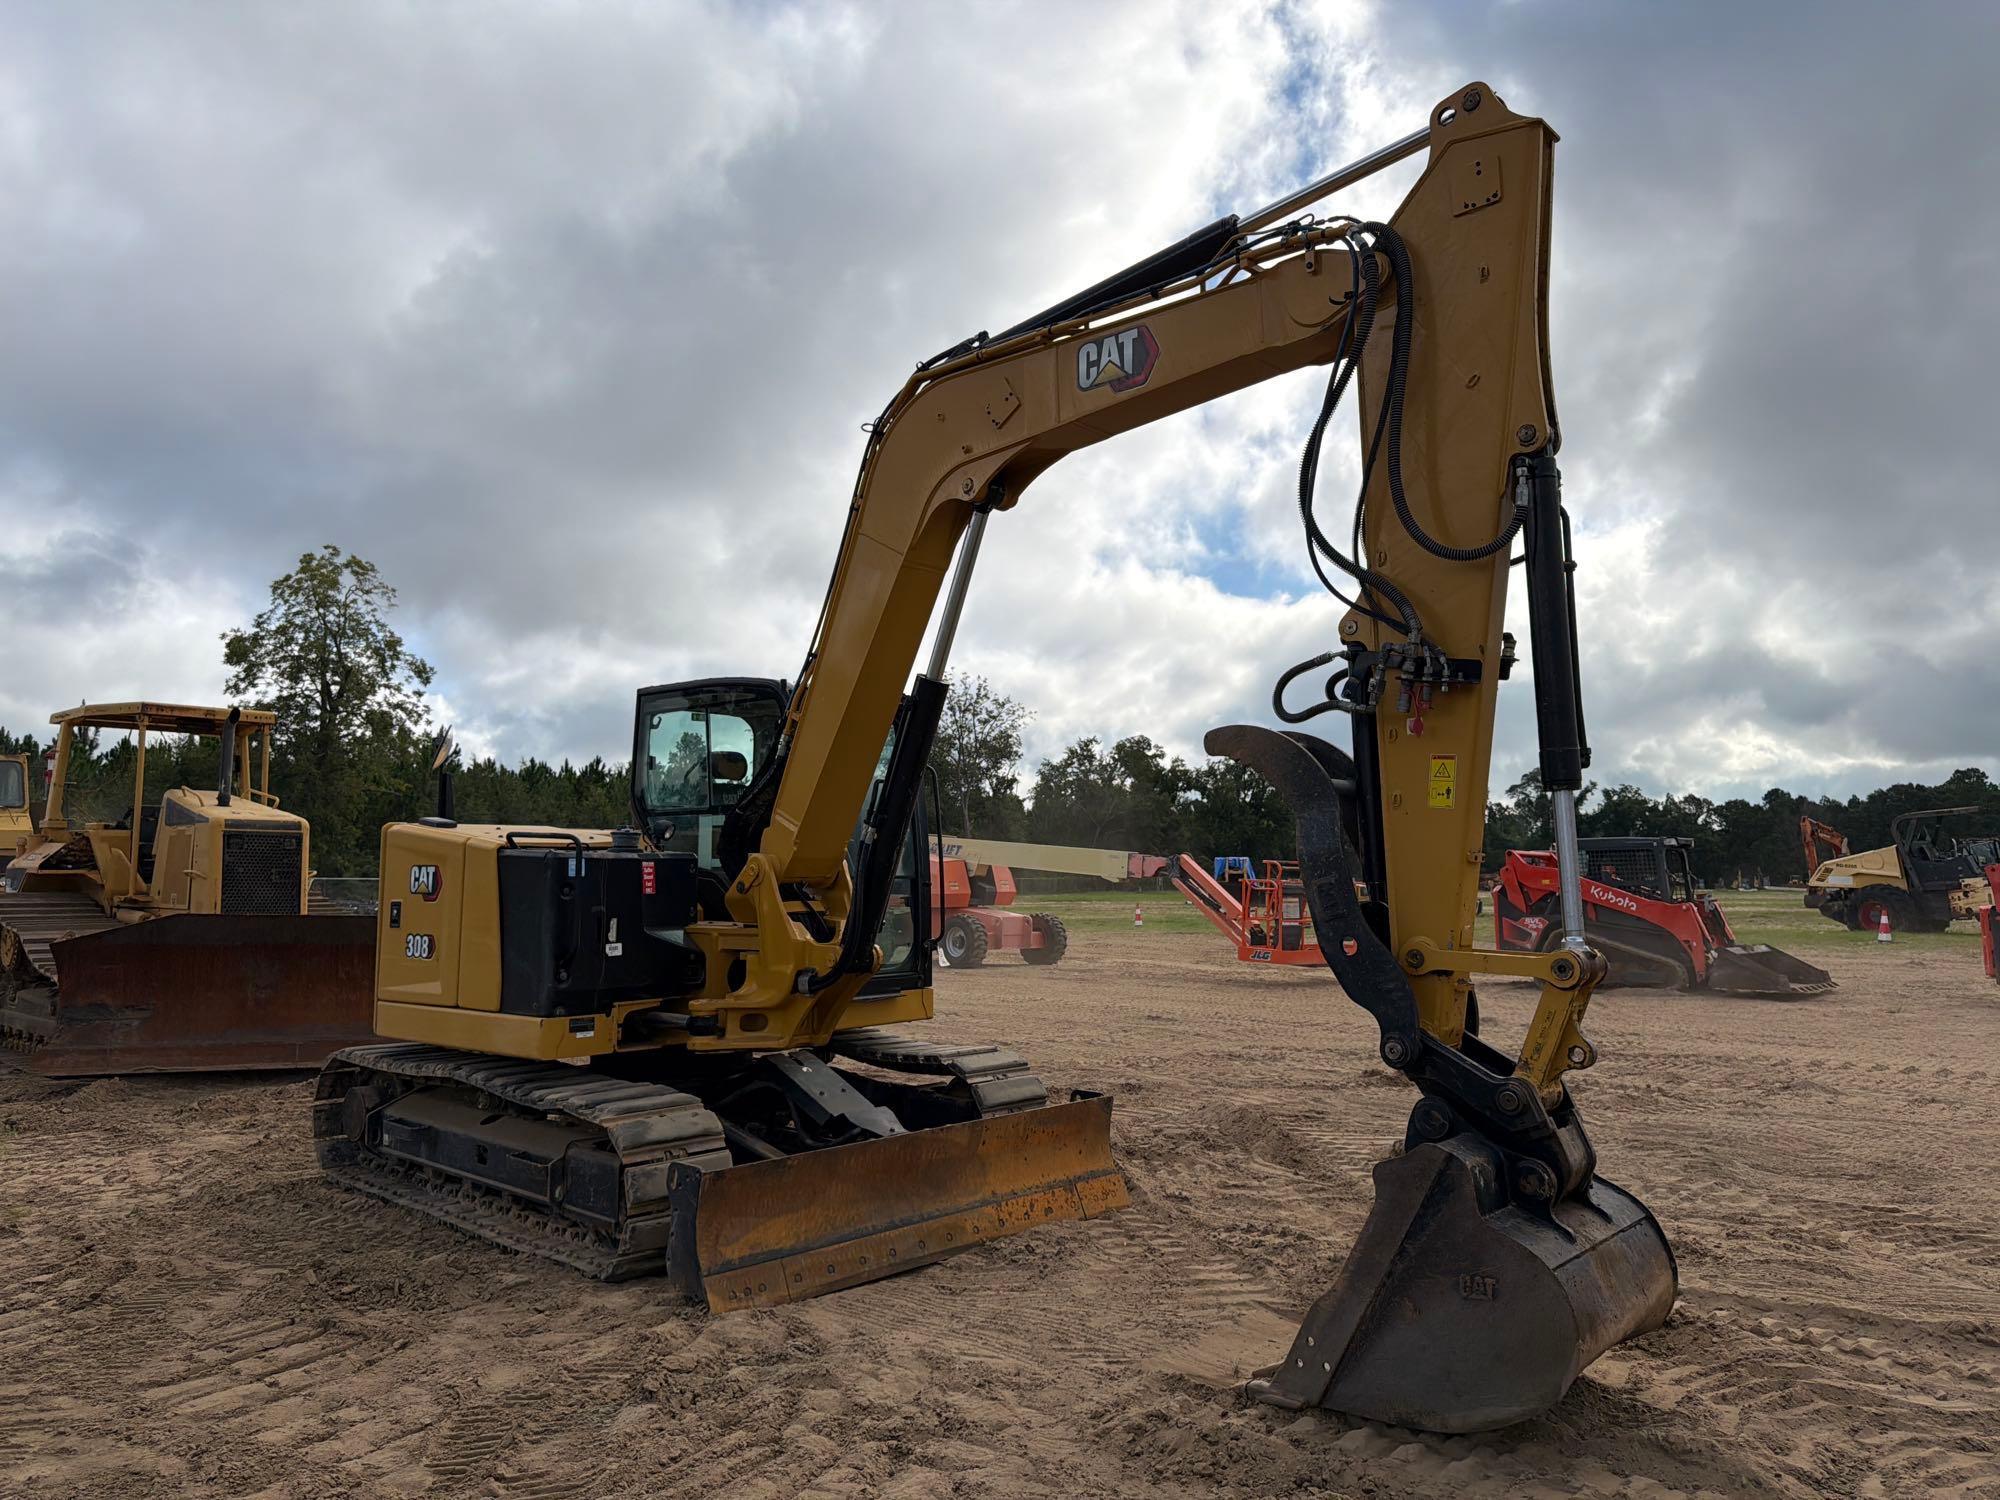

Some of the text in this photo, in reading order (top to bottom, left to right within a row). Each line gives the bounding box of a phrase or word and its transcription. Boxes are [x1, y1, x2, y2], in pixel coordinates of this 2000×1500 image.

[1078, 328, 1139, 389] CAT
[410, 865, 436, 894] CAT
[1590, 885, 1637, 911] Kubota
[406, 934, 429, 958] 308
[1249, 950, 1272, 960] JLG
[1460, 1276, 1496, 1300] CAT
